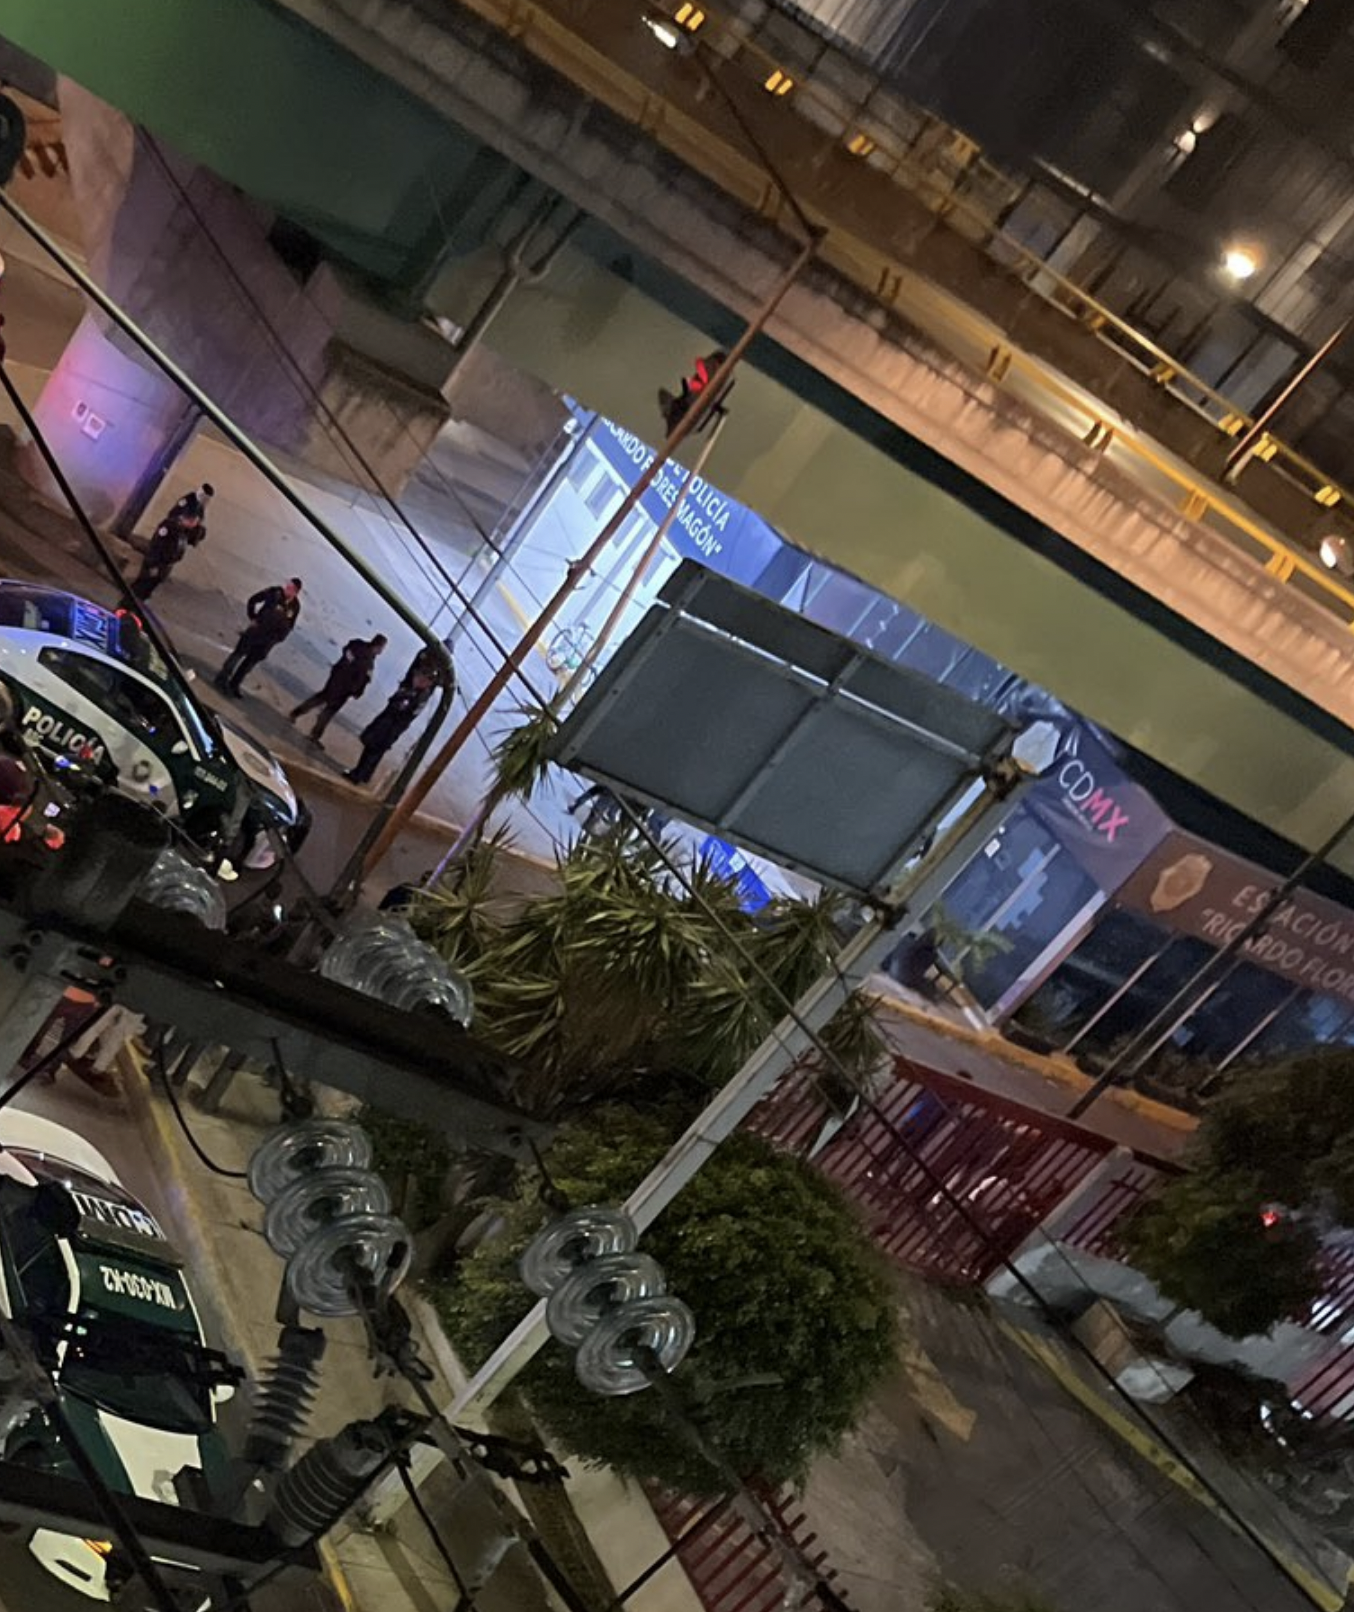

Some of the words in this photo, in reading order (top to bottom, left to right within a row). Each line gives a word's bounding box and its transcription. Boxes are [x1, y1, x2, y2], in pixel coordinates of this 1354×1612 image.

[1059, 759, 1129, 842] CDMX
[1232, 885, 1354, 954] ESACIÓN
[1299, 956, 1354, 1001] FLOR
